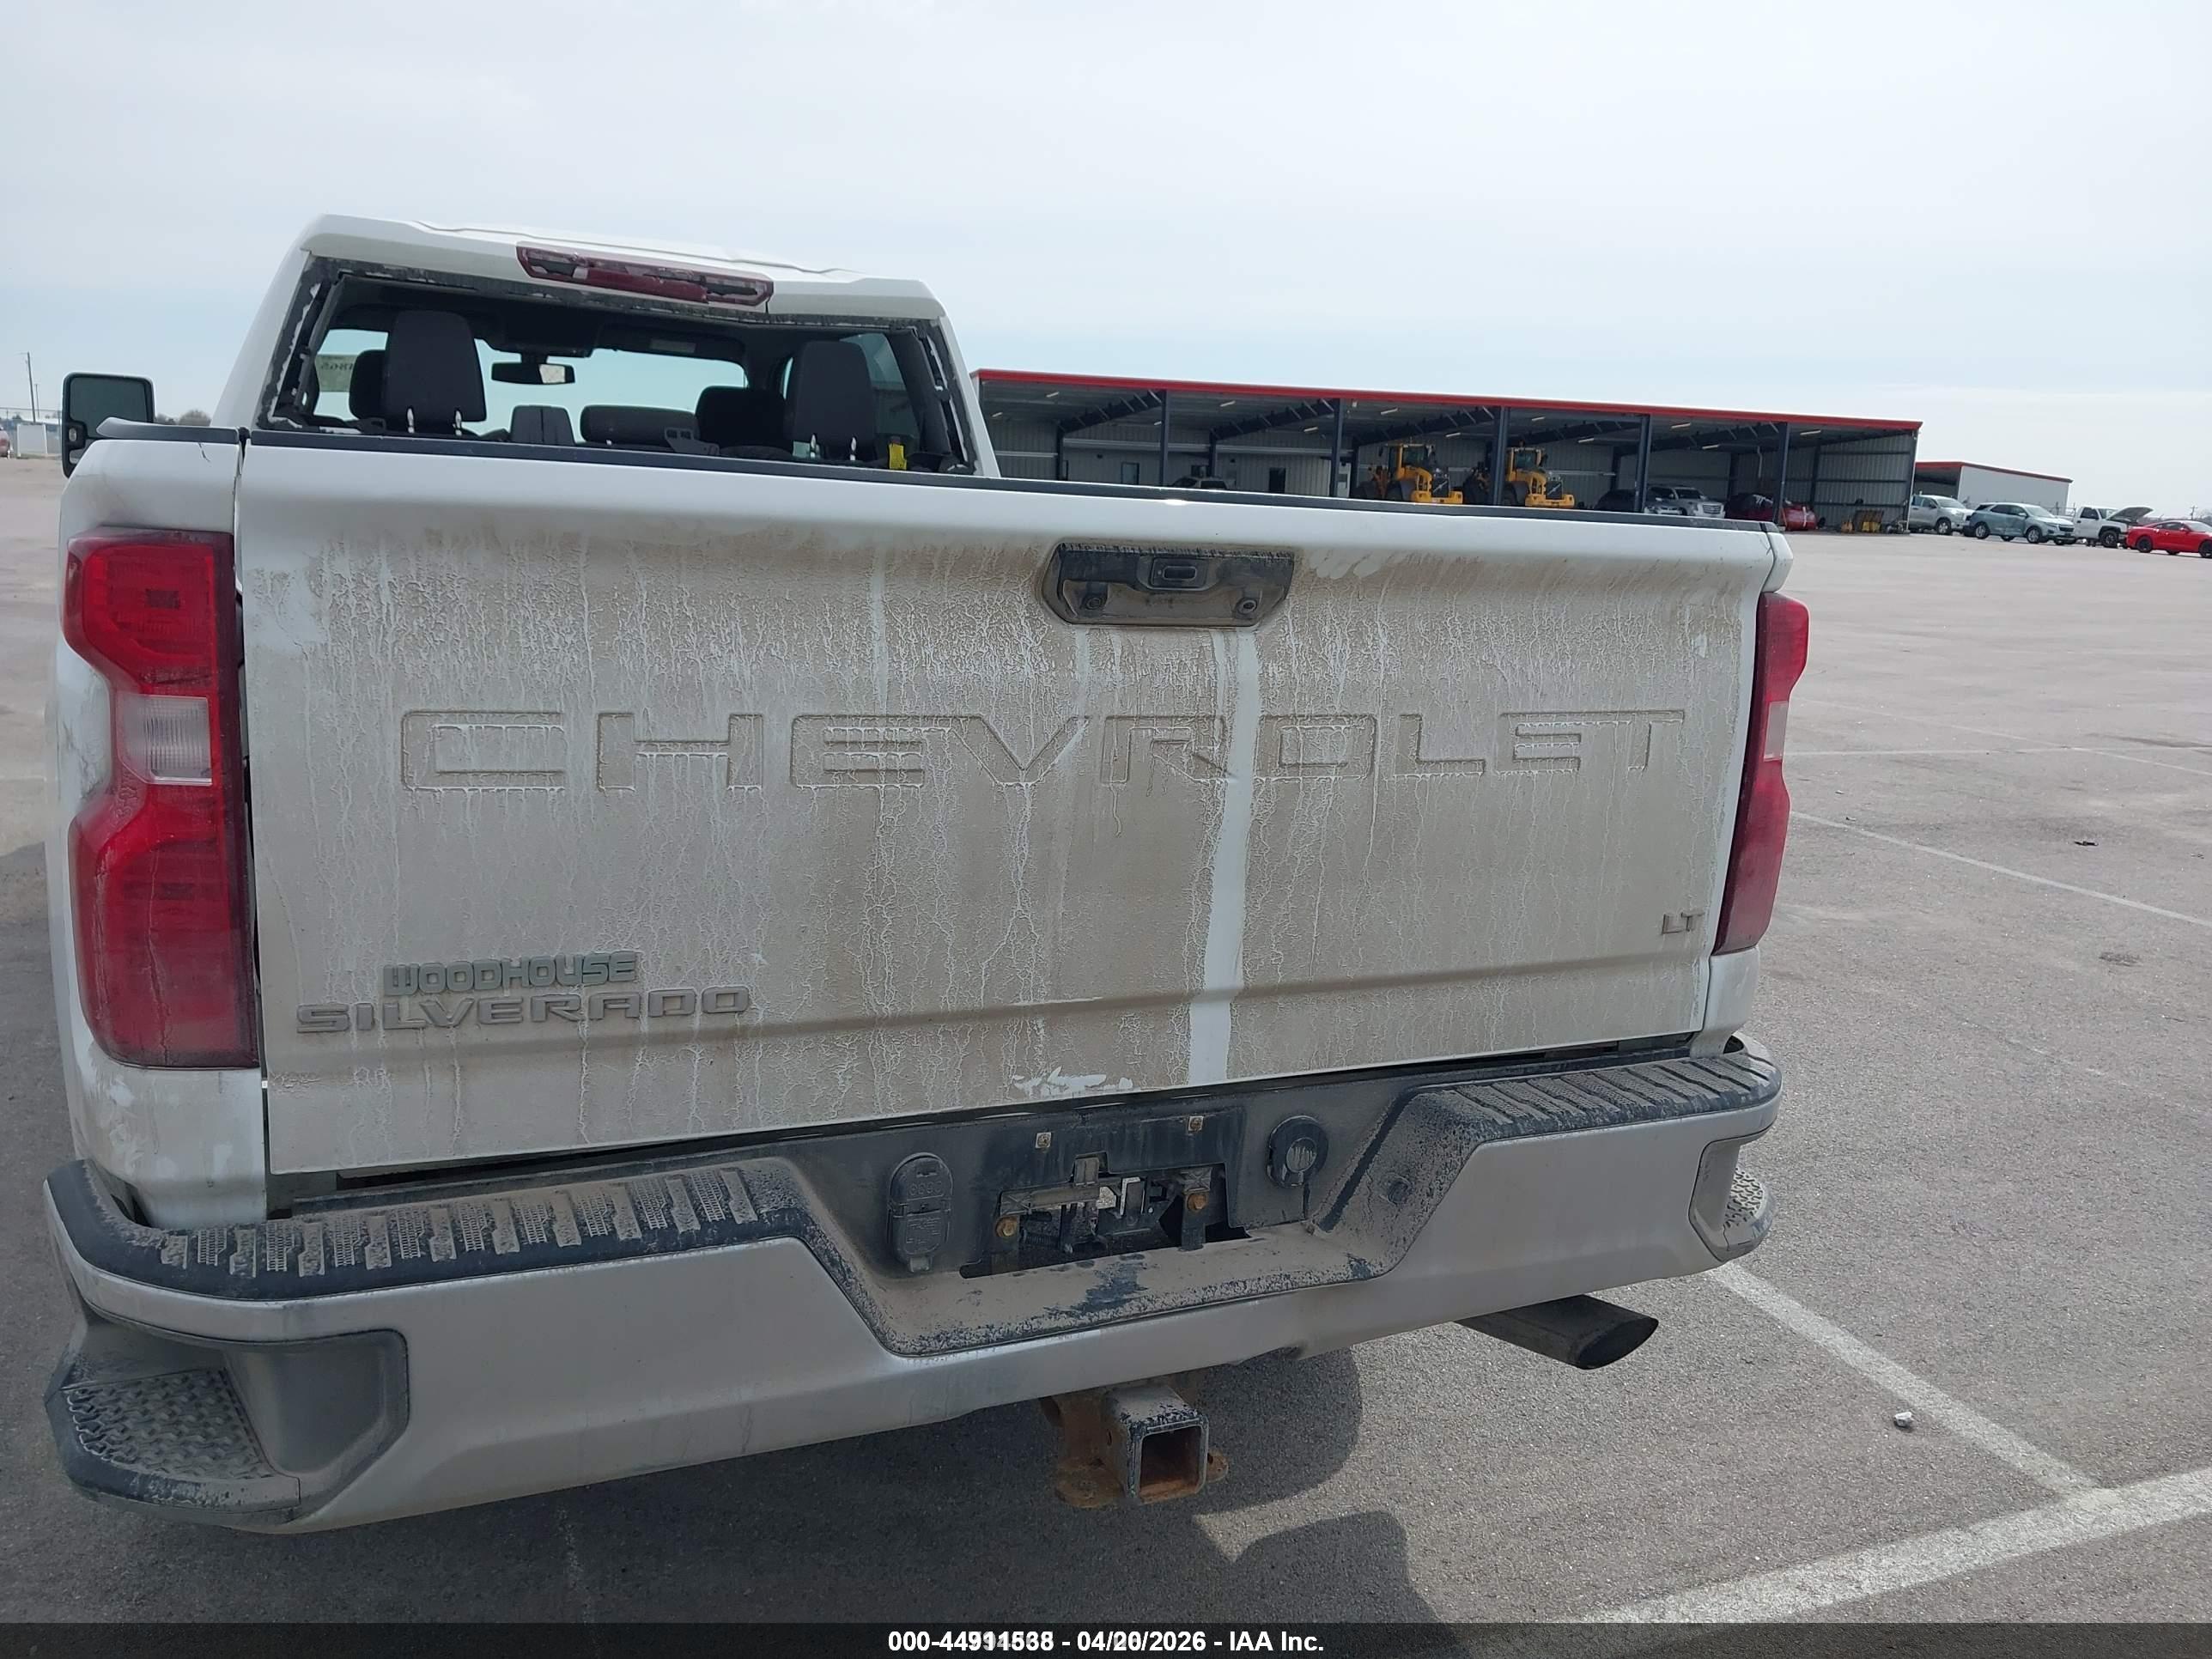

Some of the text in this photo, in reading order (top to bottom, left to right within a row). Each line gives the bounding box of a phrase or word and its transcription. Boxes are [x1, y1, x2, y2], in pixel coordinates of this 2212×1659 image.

[401, 709, 1686, 792] CHEVROLET
[1662, 911, 1705, 934] LT
[384, 951, 637, 996] WOODHOUSE
[296, 987, 750, 1034] SILVERADO
